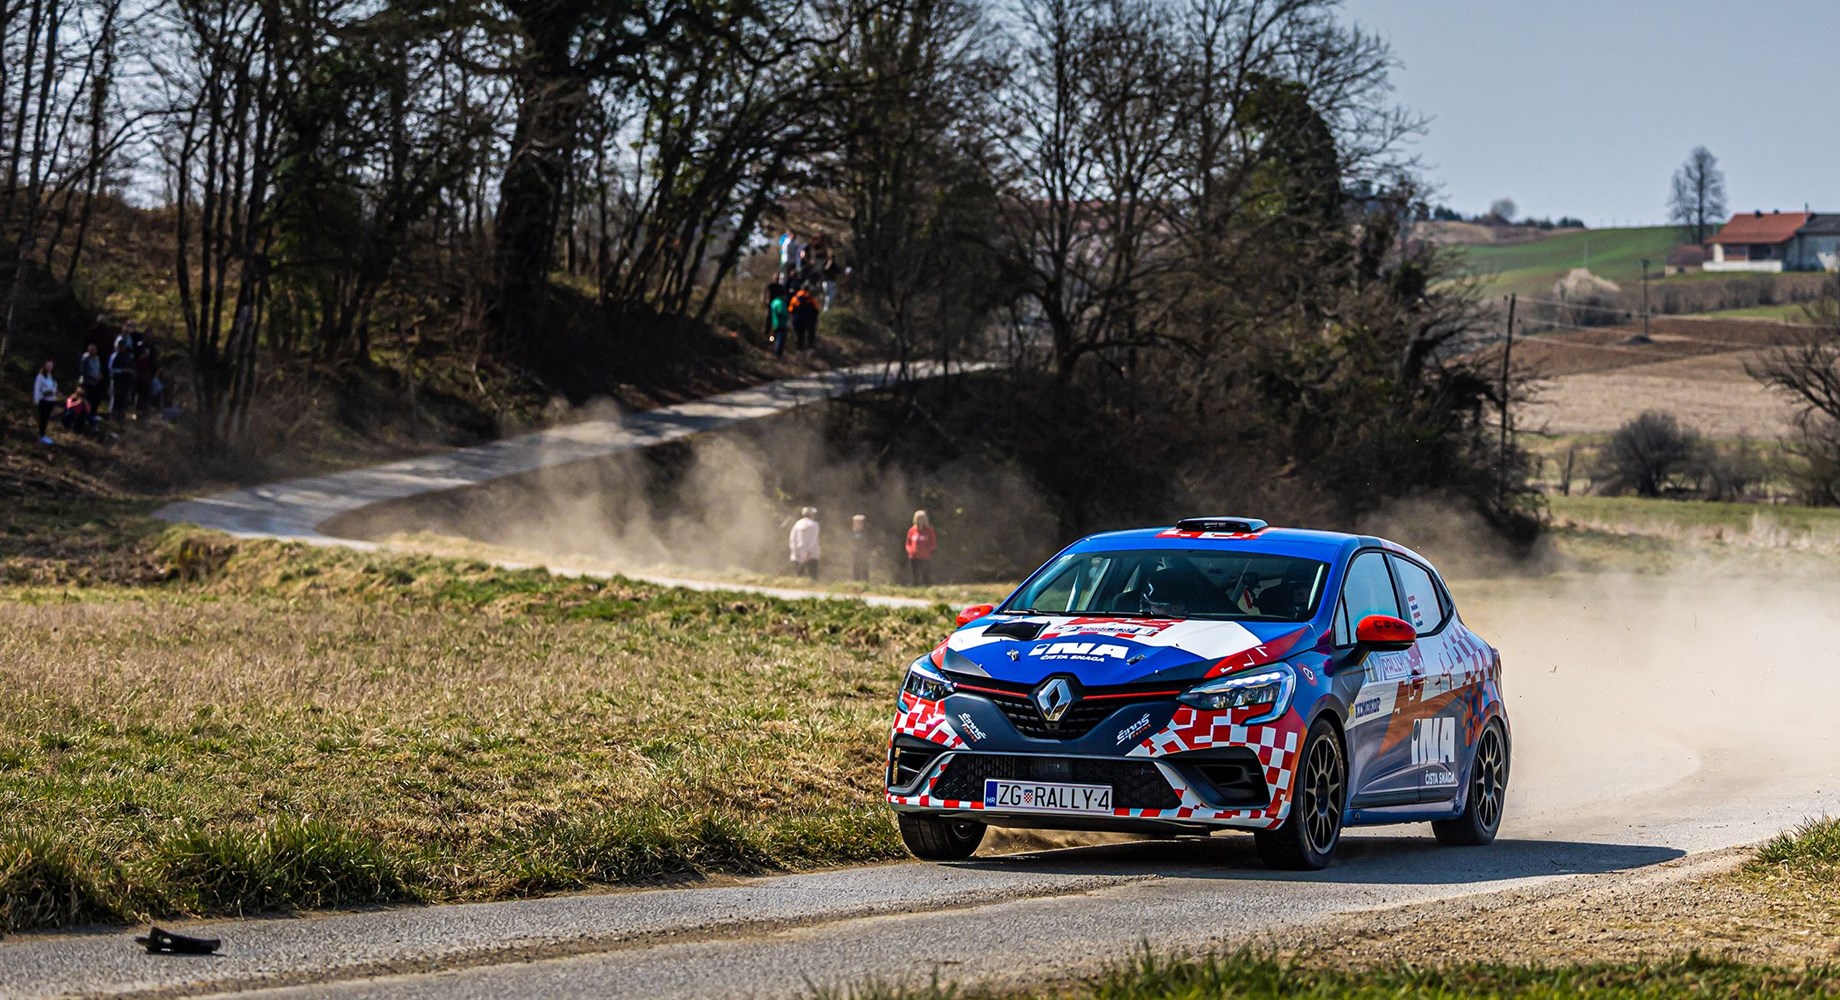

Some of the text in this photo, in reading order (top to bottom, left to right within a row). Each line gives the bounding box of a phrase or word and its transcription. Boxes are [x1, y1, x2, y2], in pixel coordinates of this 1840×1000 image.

[1069, 655, 1104, 663] SNAGA
[999, 785, 1022, 806] ZG
[986, 796, 996, 804] HR
